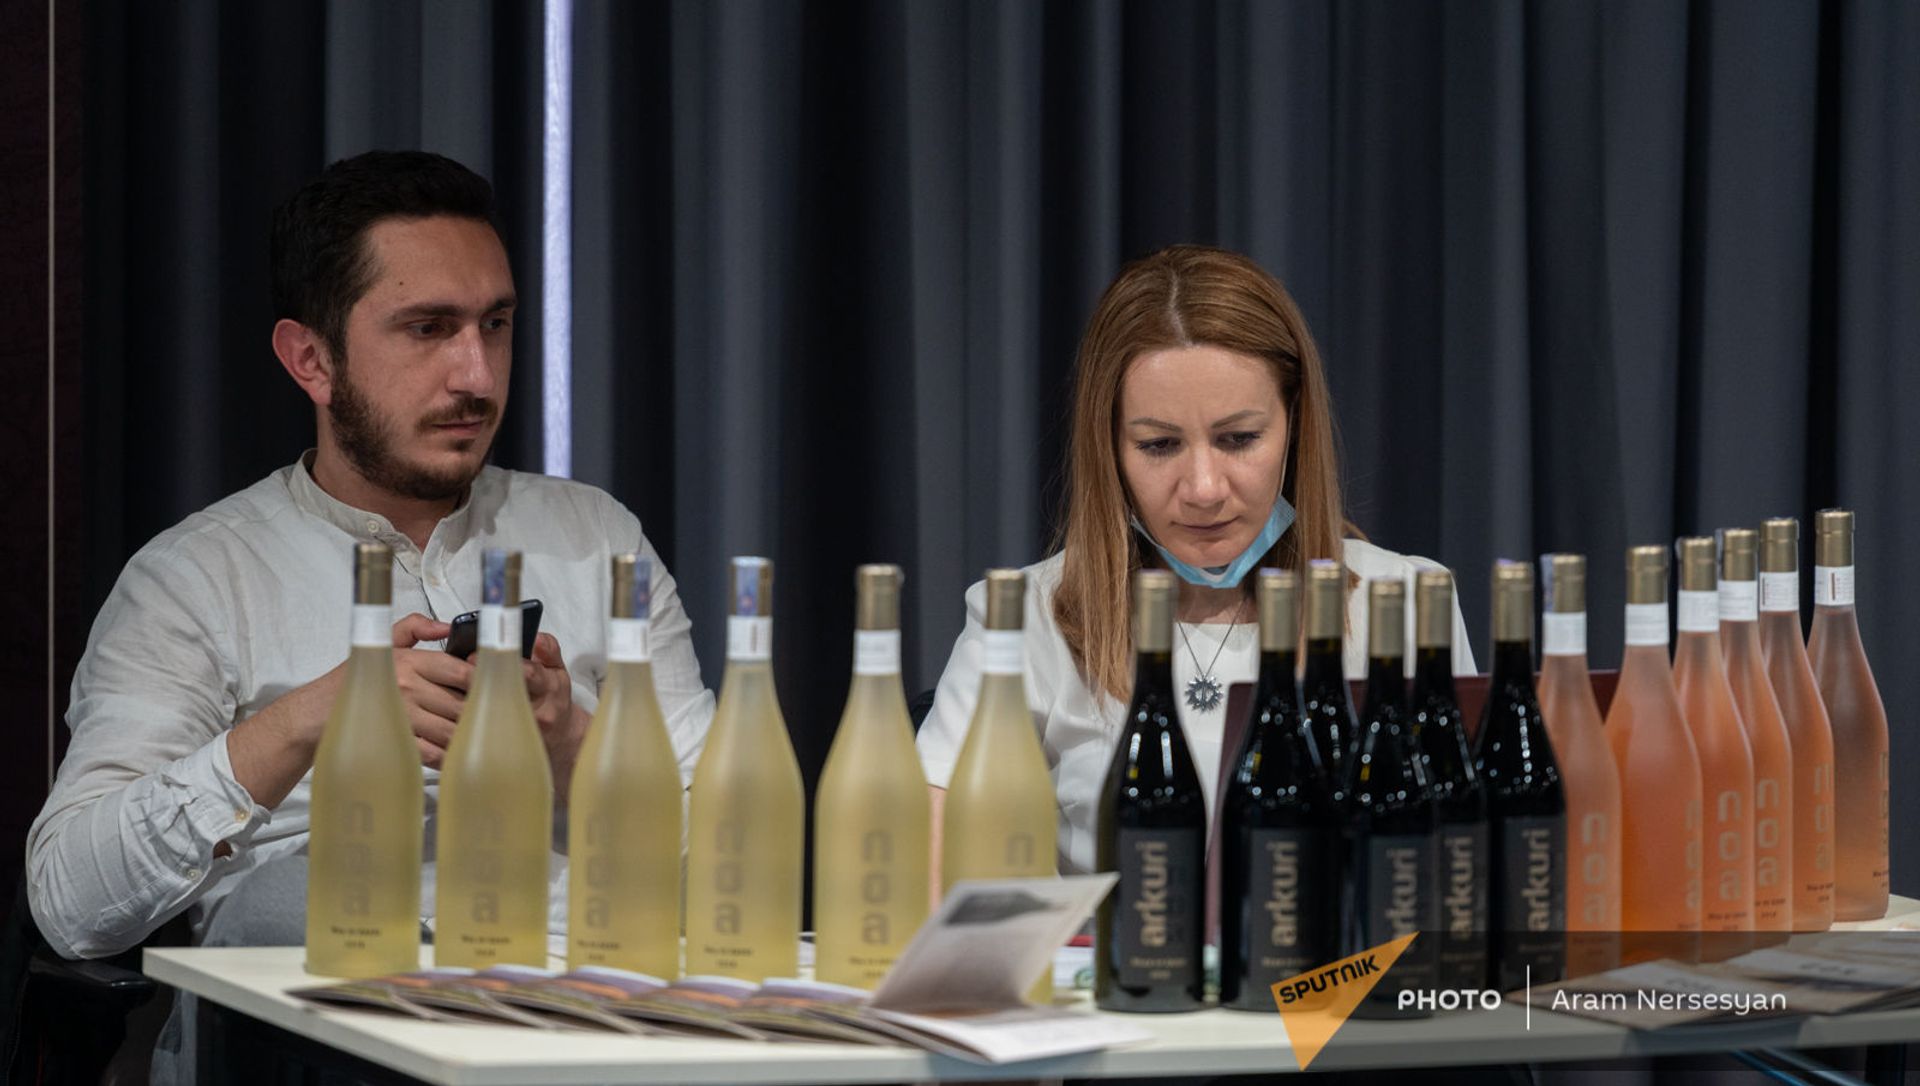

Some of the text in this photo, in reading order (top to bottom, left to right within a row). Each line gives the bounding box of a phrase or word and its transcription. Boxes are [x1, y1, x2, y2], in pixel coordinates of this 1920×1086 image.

[1521, 829, 1549, 932] arkuri
[1581, 811, 1608, 925] noa
[1718, 790, 1743, 902] noa
[1757, 778, 1780, 887] noa
[861, 830, 893, 945] noa
[1136, 841, 1168, 948] arkuri
[1265, 841, 1298, 948] arkuri
[1445, 836, 1473, 941] arkuri
